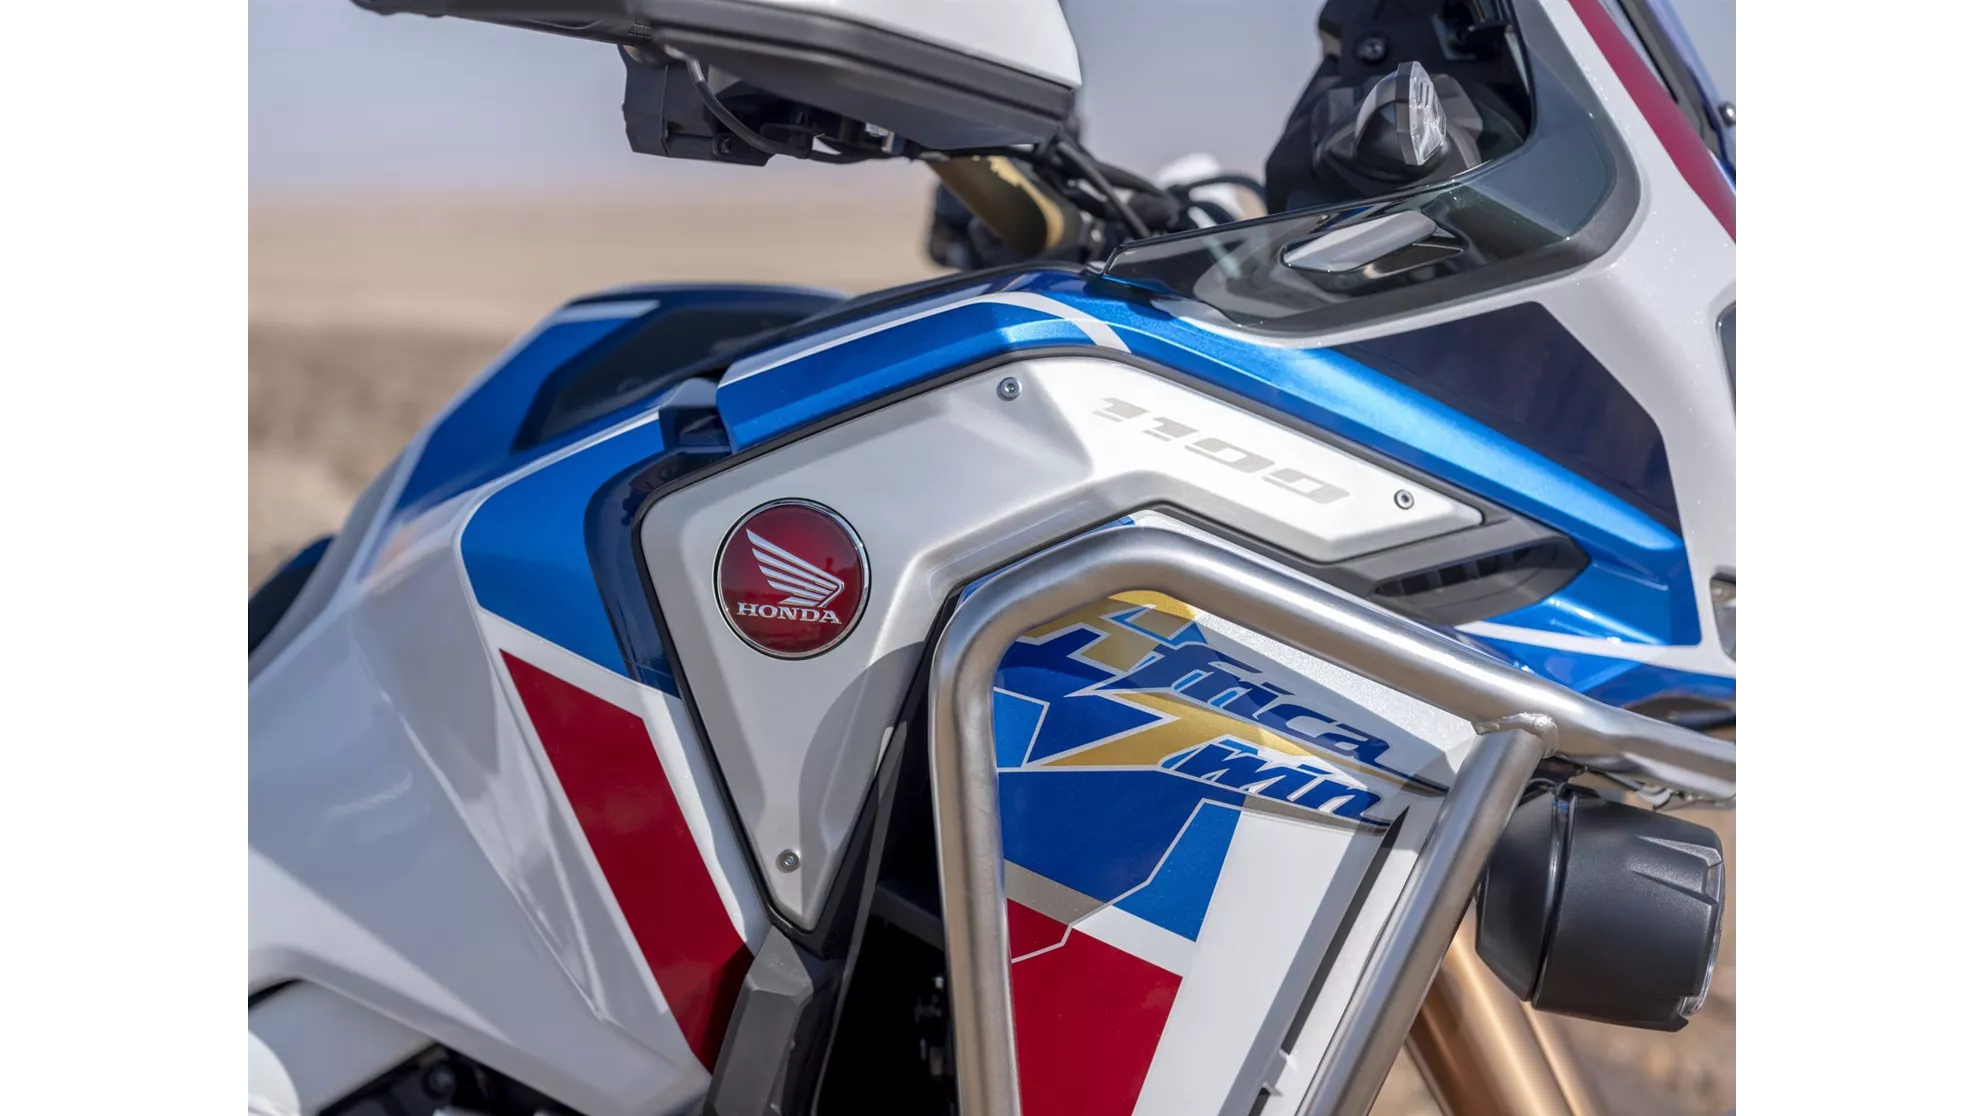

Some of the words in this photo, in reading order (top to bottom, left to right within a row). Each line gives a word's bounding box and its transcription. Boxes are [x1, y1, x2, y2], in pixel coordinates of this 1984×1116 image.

[1092, 397, 1351, 504] 1100
[736, 602, 842, 625] HONDA
[1022, 591, 1447, 793] Africa
[1040, 693, 1403, 828] Twin
